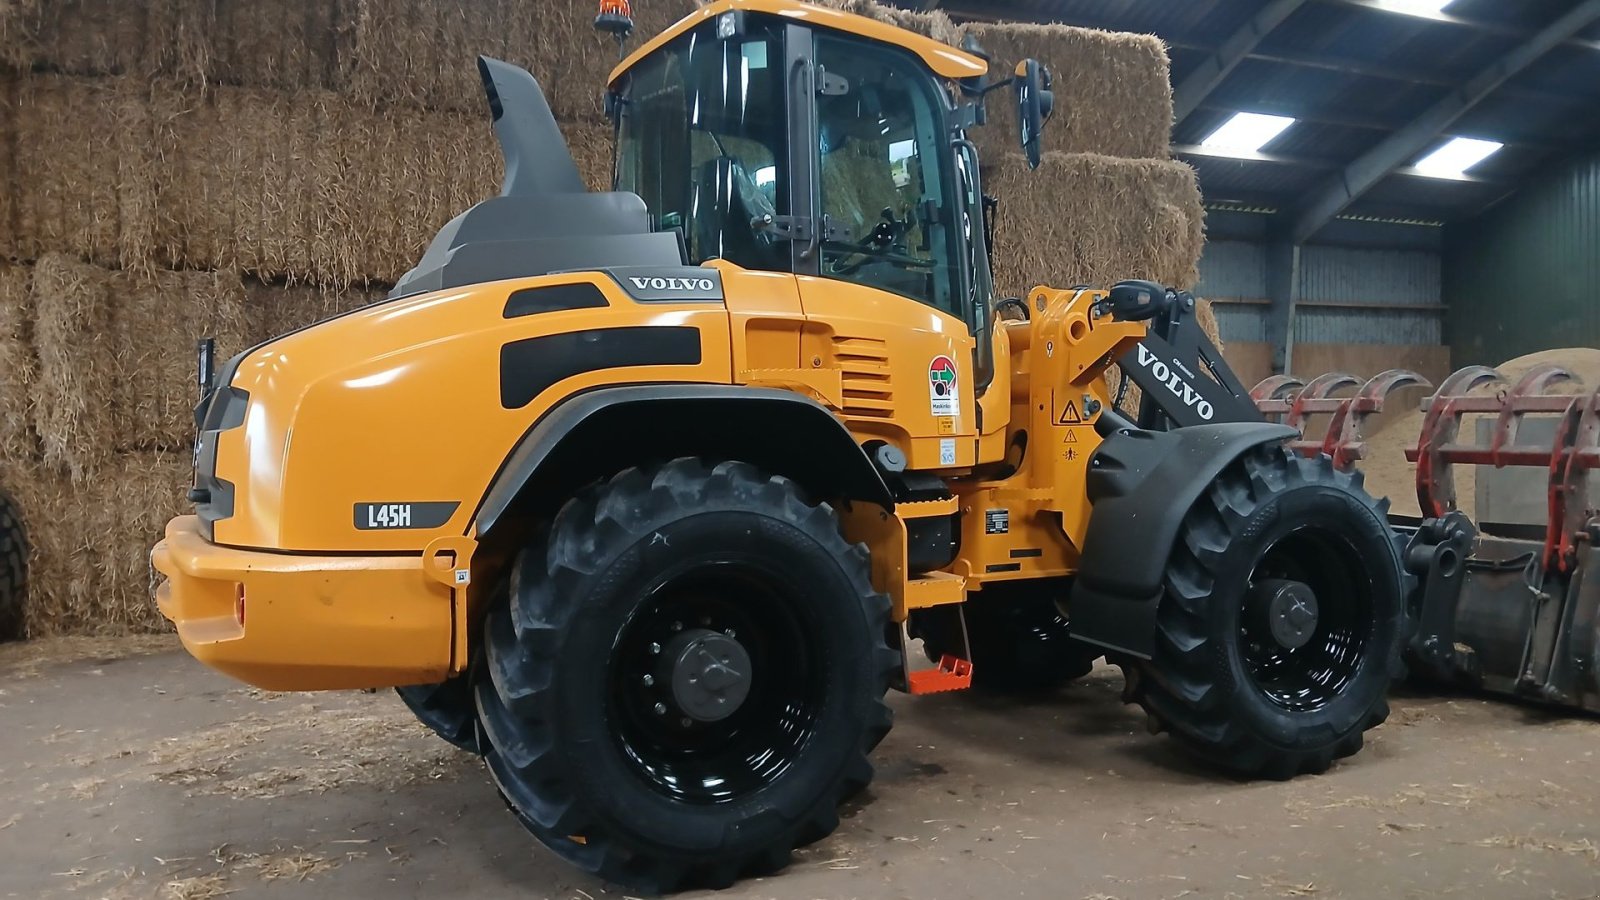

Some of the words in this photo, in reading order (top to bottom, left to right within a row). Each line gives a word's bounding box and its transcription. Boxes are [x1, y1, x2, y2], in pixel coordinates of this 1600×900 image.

[629, 277, 714, 291] VOLVO
[1137, 342, 1214, 420] VOLVO
[368, 504, 411, 527] L45H
